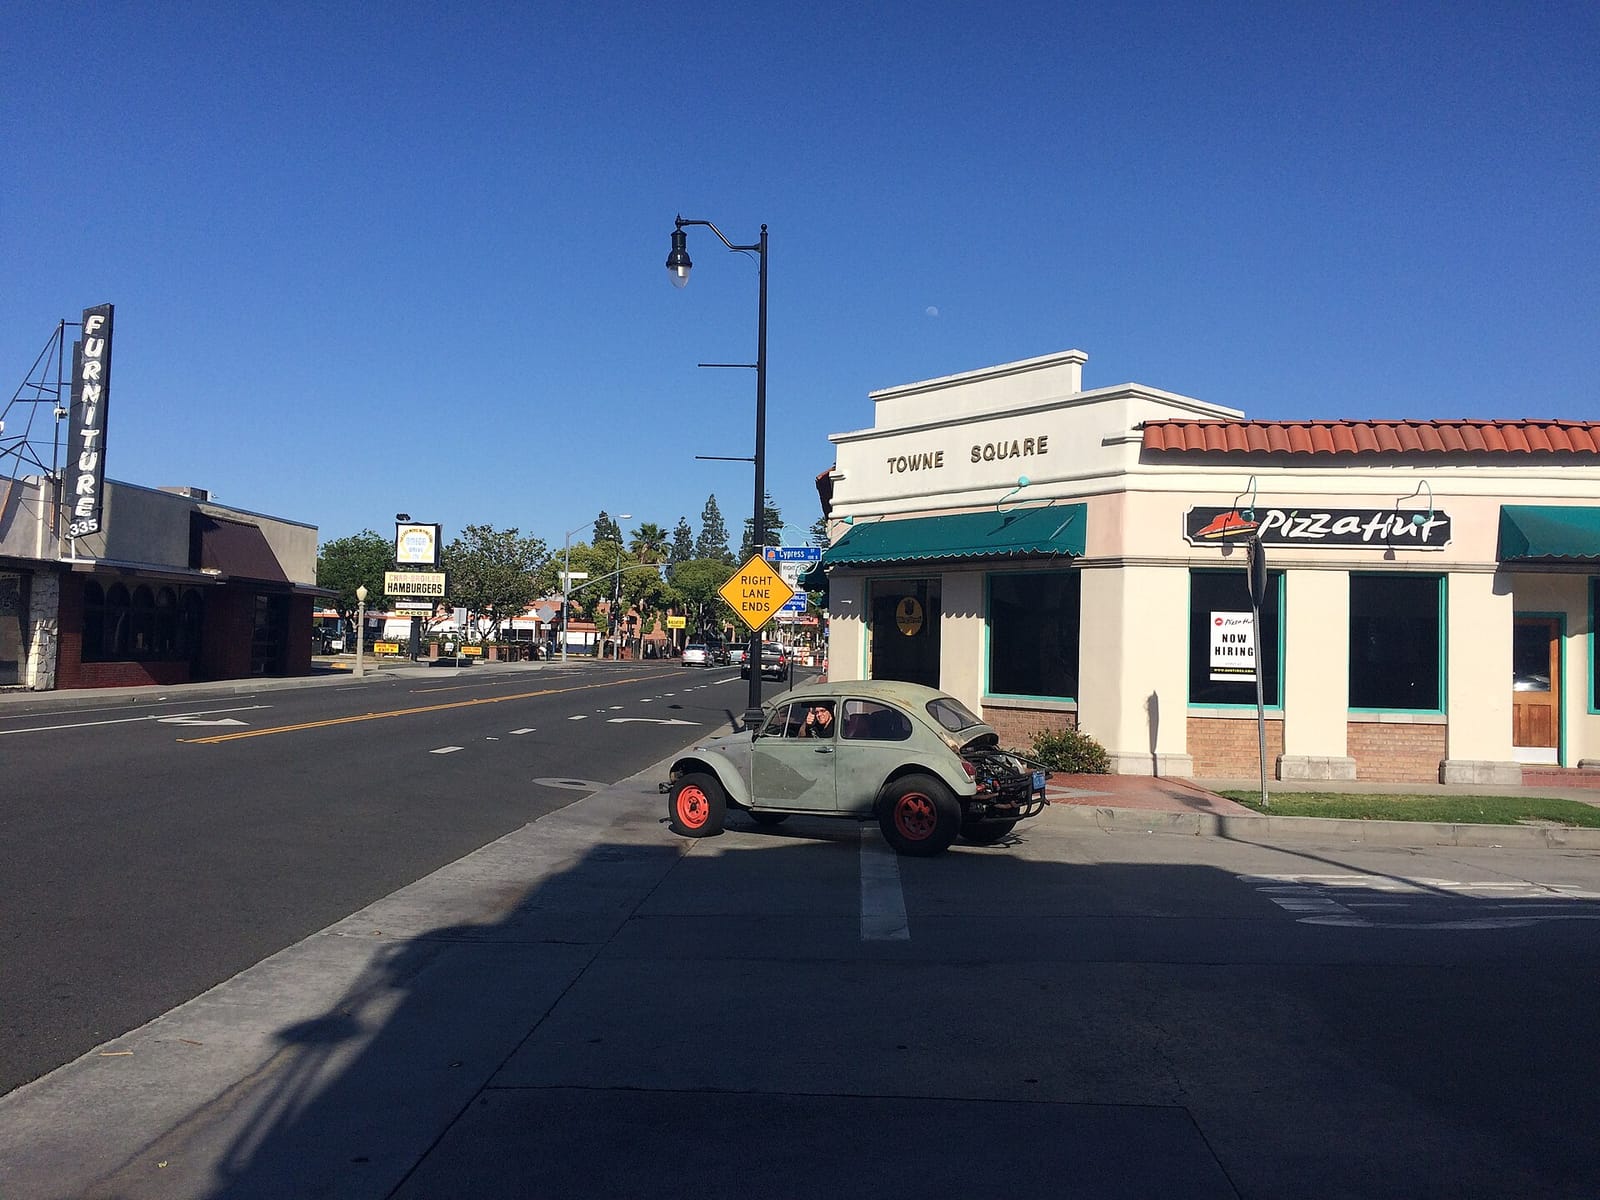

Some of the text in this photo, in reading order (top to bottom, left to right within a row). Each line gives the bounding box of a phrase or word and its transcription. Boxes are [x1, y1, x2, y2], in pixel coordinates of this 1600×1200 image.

[75, 315, 105, 517] FURNITURE
[887, 435, 1048, 474] TOWNE SQUARE
[70, 519, 98, 536] 335
[1257, 509, 1448, 542] Pizza Hut
[780, 550, 805, 559] Cypress
[741, 576, 772, 585] RIGHT
[387, 583, 442, 593] HAMBURGERS
[743, 589, 770, 598] LANE
[742, 602, 770, 611] ENDS
[1222, 634, 1246, 643] NOW
[1215, 646, 1254, 656] HIRING
